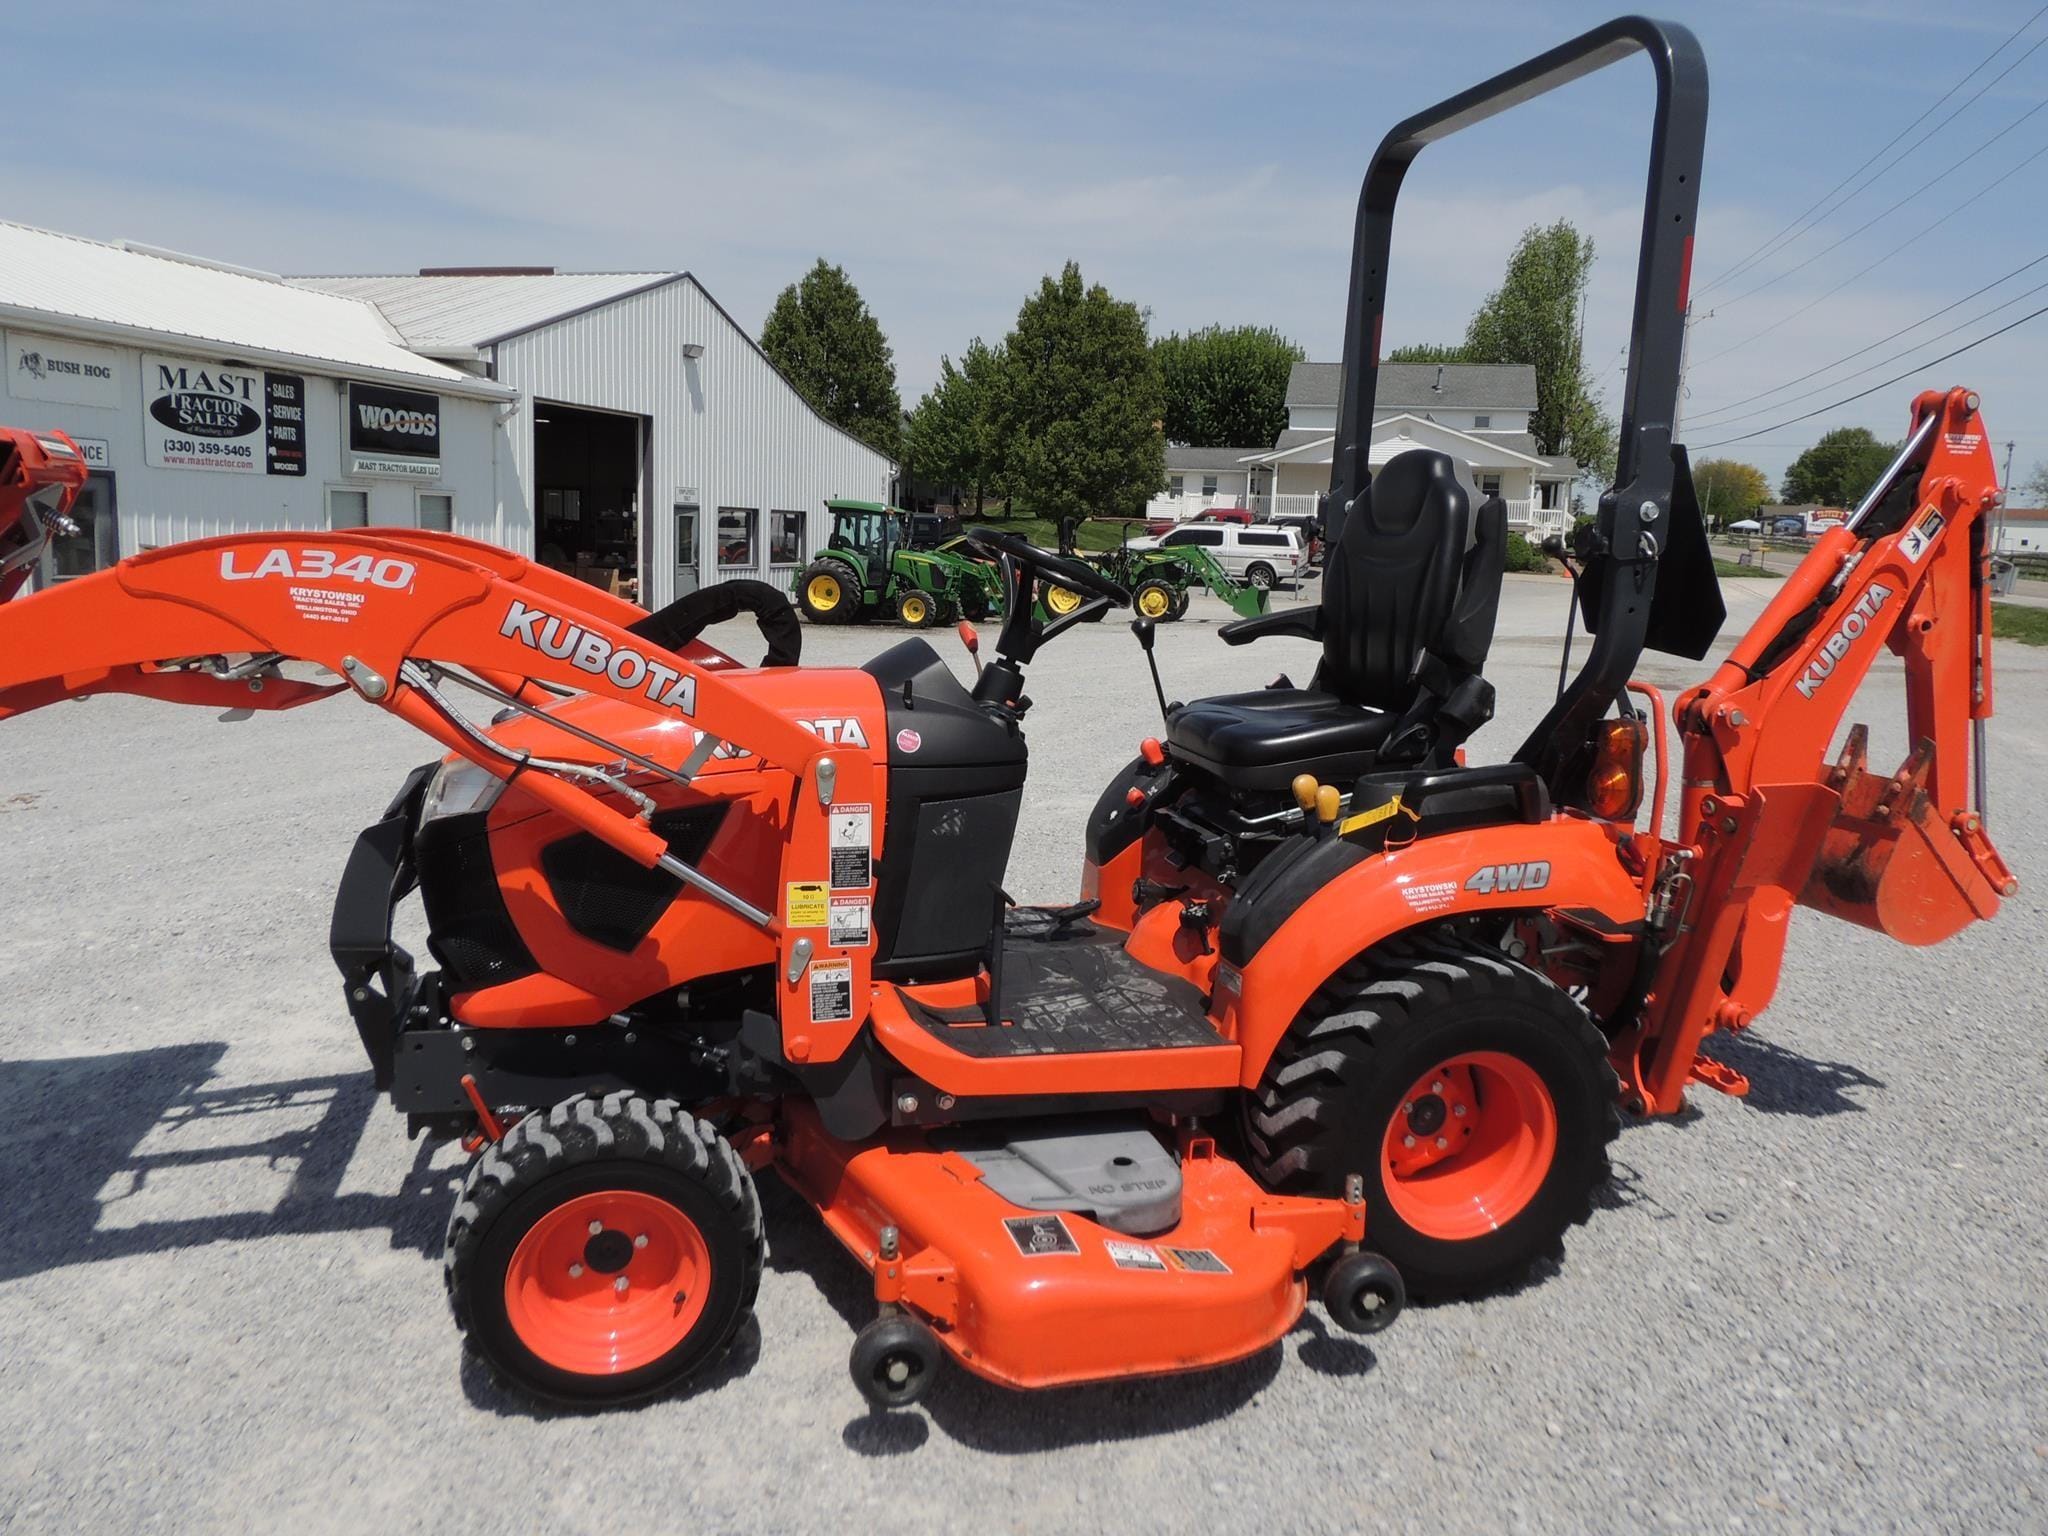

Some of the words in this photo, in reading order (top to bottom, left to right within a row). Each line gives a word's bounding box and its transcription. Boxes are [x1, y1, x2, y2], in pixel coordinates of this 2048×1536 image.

[47, 359, 80, 375] BUSH
[84, 364, 111, 379] HOG
[158, 364, 256, 401] MAST
[272, 384, 295, 399] SALES
[169, 393, 243, 416] TRACTOR
[179, 409, 238, 428] SALES
[273, 405, 302, 421] SERVICE
[358, 404, 438, 437] WOODS
[273, 425, 297, 441] PARTS
[164, 439, 196, 455] (330)
[198, 442, 252, 457] 359-5405
[163, 455, 253, 469] www.masttractor.com
[358, 461, 377, 471] MAST
[379, 463, 408, 473] TRACTOR
[409, 465, 427, 475] SALES
[428, 466, 440, 476] LLC
[220, 549, 416, 589] LA340
[289, 587, 365, 603] KRYSTOWSKI
[292, 596, 324, 604] TRACTOR
[1795, 582, 1894, 701] KUBOTA
[499, 599, 698, 719] KUBOTA
[1464, 860, 1551, 895] 4WD
[1401, 881, 1458, 896] KRYSTOWSKI
[839, 898, 868, 906] DANGER
[819, 961, 848, 970] WARNING
[1088, 1184, 1116, 1195] NO
[1120, 1179, 1168, 1192] STEP
